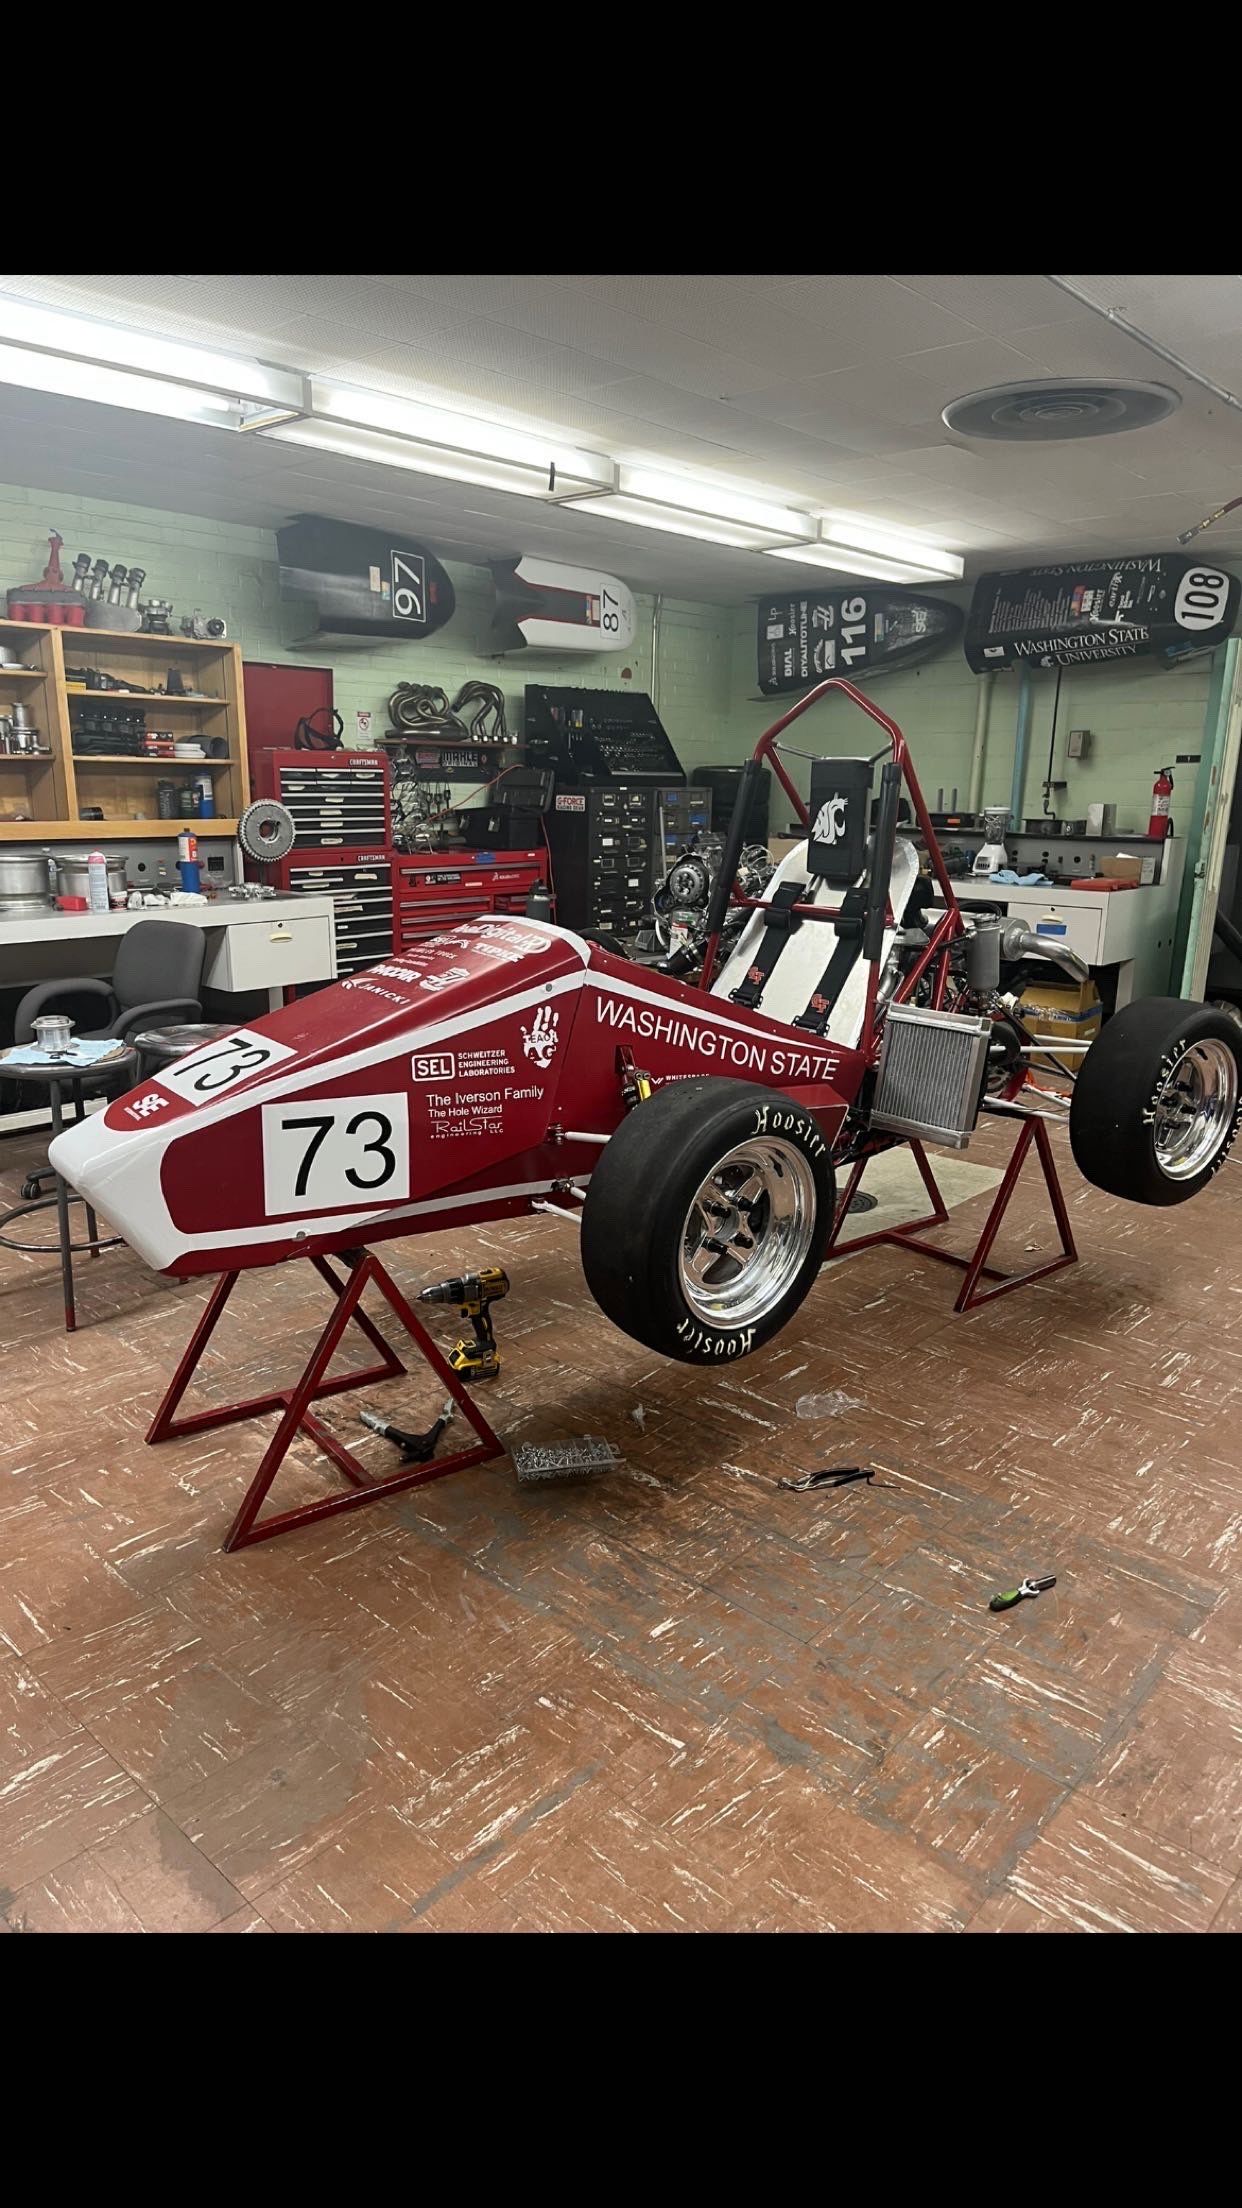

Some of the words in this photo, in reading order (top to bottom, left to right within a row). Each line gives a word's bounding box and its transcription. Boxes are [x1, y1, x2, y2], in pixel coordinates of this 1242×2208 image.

[394, 557, 421, 616] 97
[1181, 573, 1224, 622] 108
[603, 589, 619, 633] 87
[841, 597, 867, 666] 116
[1014, 629, 1107, 656] WASHINGTON
[1108, 625, 1150, 646] STATE
[784, 648, 792, 677] DIAL
[1057, 644, 1137, 666] UNIVERSITY
[442, 752, 478, 761] MAHLE
[358, 982, 411, 1005] JANICKI
[597, 996, 767, 1072] WASHINGTON
[770, 1051, 840, 1080] STATE
[173, 1037, 271, 1091] 73
[416, 1058, 450, 1076] SEL
[458, 1050, 506, 1060] SCHWEITZER
[458, 1058, 509, 1068] ENGINEERING
[459, 1066, 515, 1077] LABORATORIES
[426, 1094, 451, 1107] The
[455, 1090, 500, 1104] Iverson
[504, 1085, 544, 1101] Family
[428, 1108, 446, 1118] The
[448, 1107, 469, 1116] Hole
[472, 1105, 503, 1115] Wizard
[431, 1116, 503, 1133] RailStar
[430, 1131, 482, 1139] engineering
[752, 1105, 826, 1157] Hoosier
[281, 1111, 397, 1197] 73
[676, 1317, 756, 1356] Hoosier
